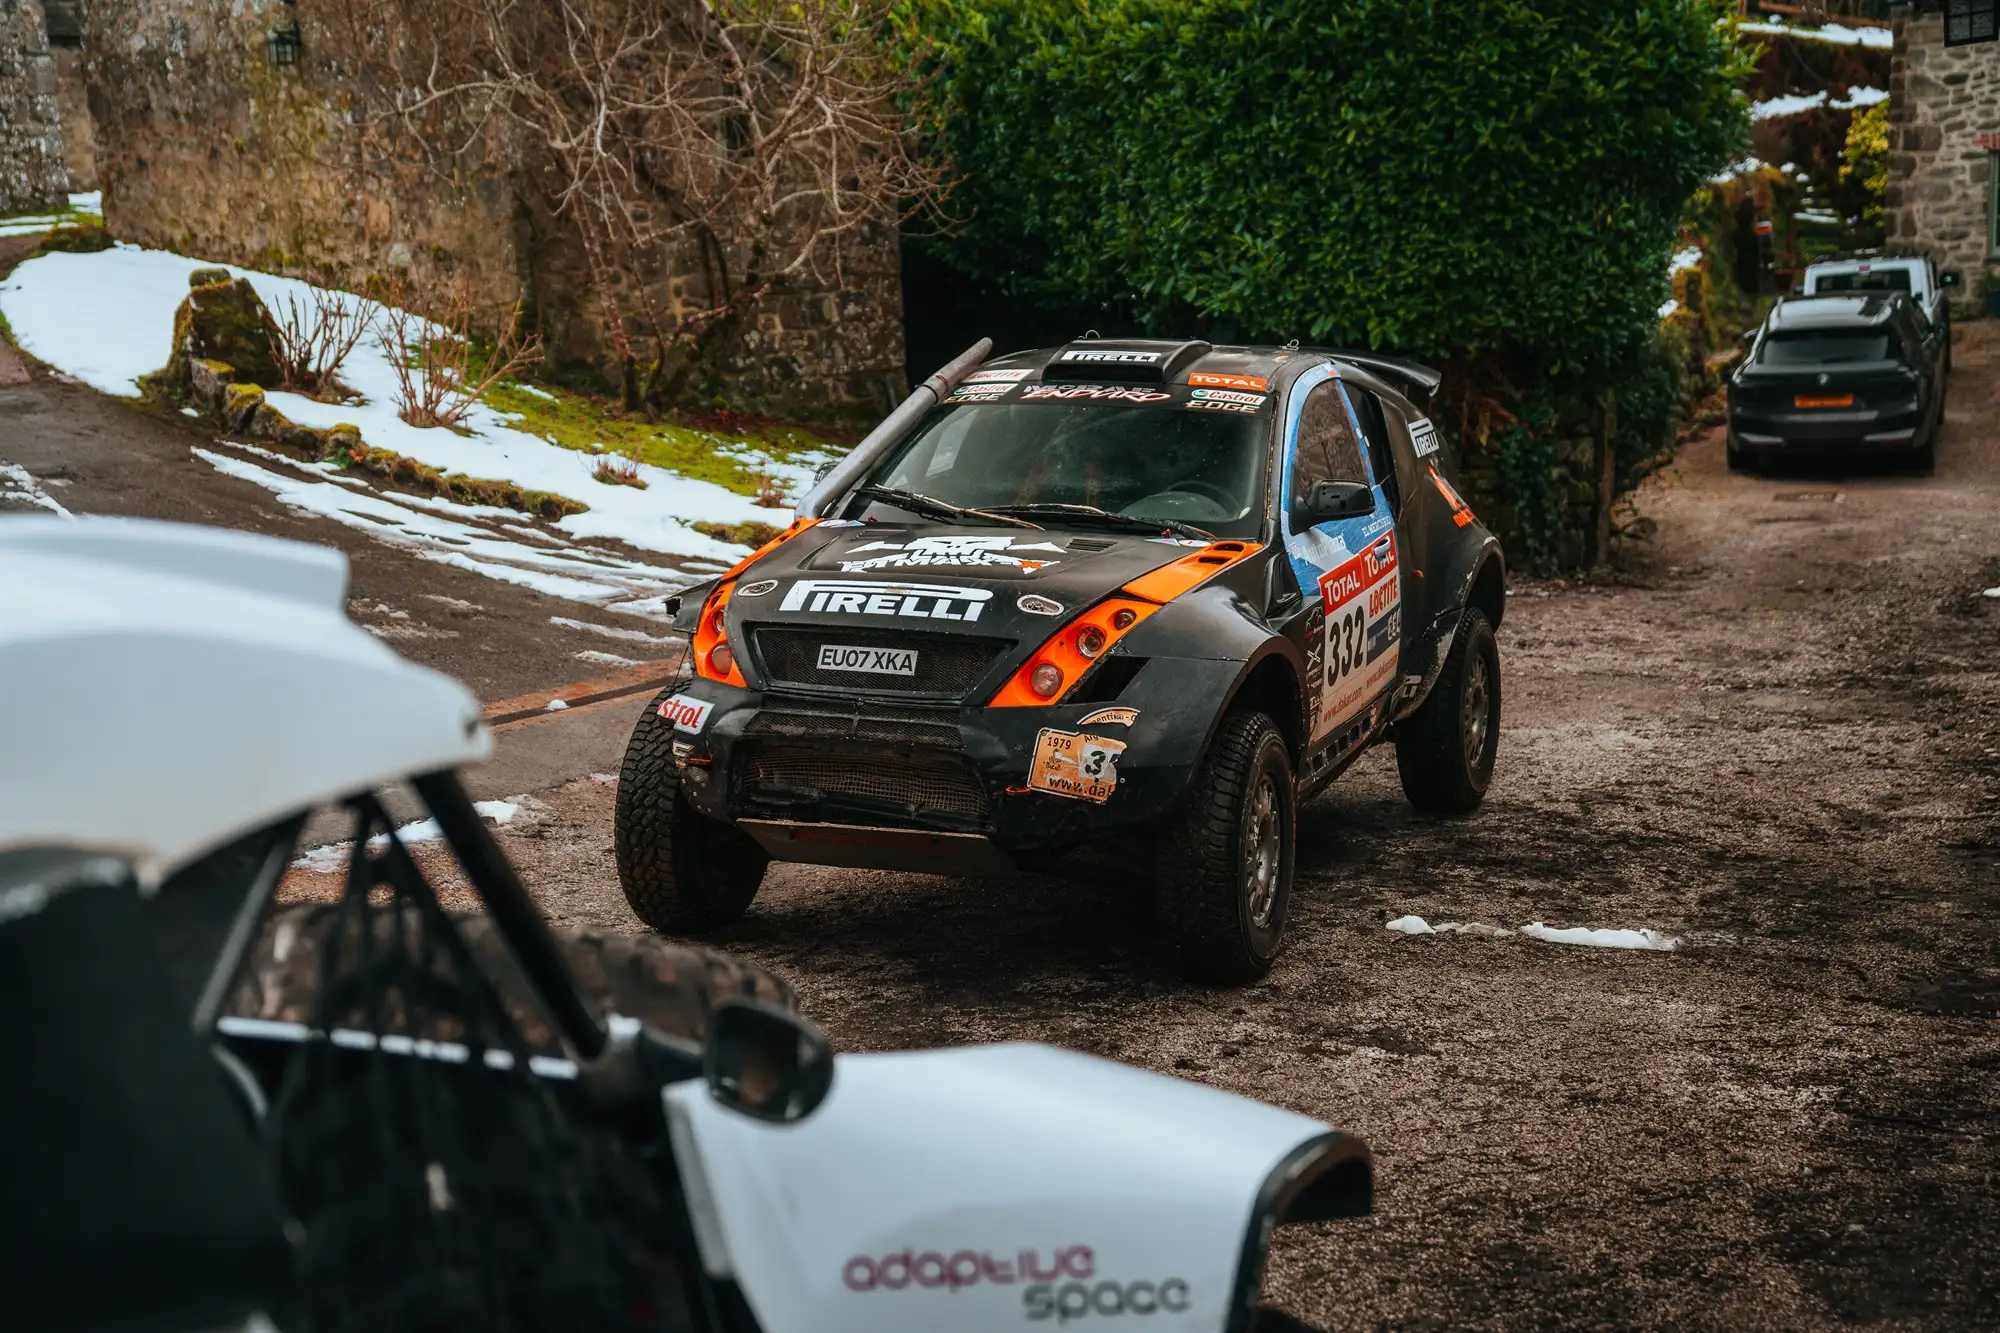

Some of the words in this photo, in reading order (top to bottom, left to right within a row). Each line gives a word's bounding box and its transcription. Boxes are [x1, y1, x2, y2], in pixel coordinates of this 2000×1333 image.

[1060, 350, 1162, 362] PIRELLI
[968, 384, 1011, 393] Castrol
[1193, 375, 1263, 388] TOTAL
[943, 393, 1005, 403] EDGE
[1184, 400, 1261, 414] EDGE
[1209, 391, 1261, 404] Castrol
[1408, 417, 1440, 458] PIRELLI
[778, 579, 995, 622] PIRELLI
[1324, 570, 1361, 606] TOTAL
[1368, 574, 1398, 619] LOCTITE
[820, 647, 870, 668] EU07
[871, 651, 914, 673] XKA
[1328, 605, 1365, 688] 332
[1366, 653, 1398, 689] www.dakar.com
[1323, 685, 1363, 723] www.dakar.com
[1047, 736, 1072, 750] 1979
[1021, 1277, 1191, 1327] space
